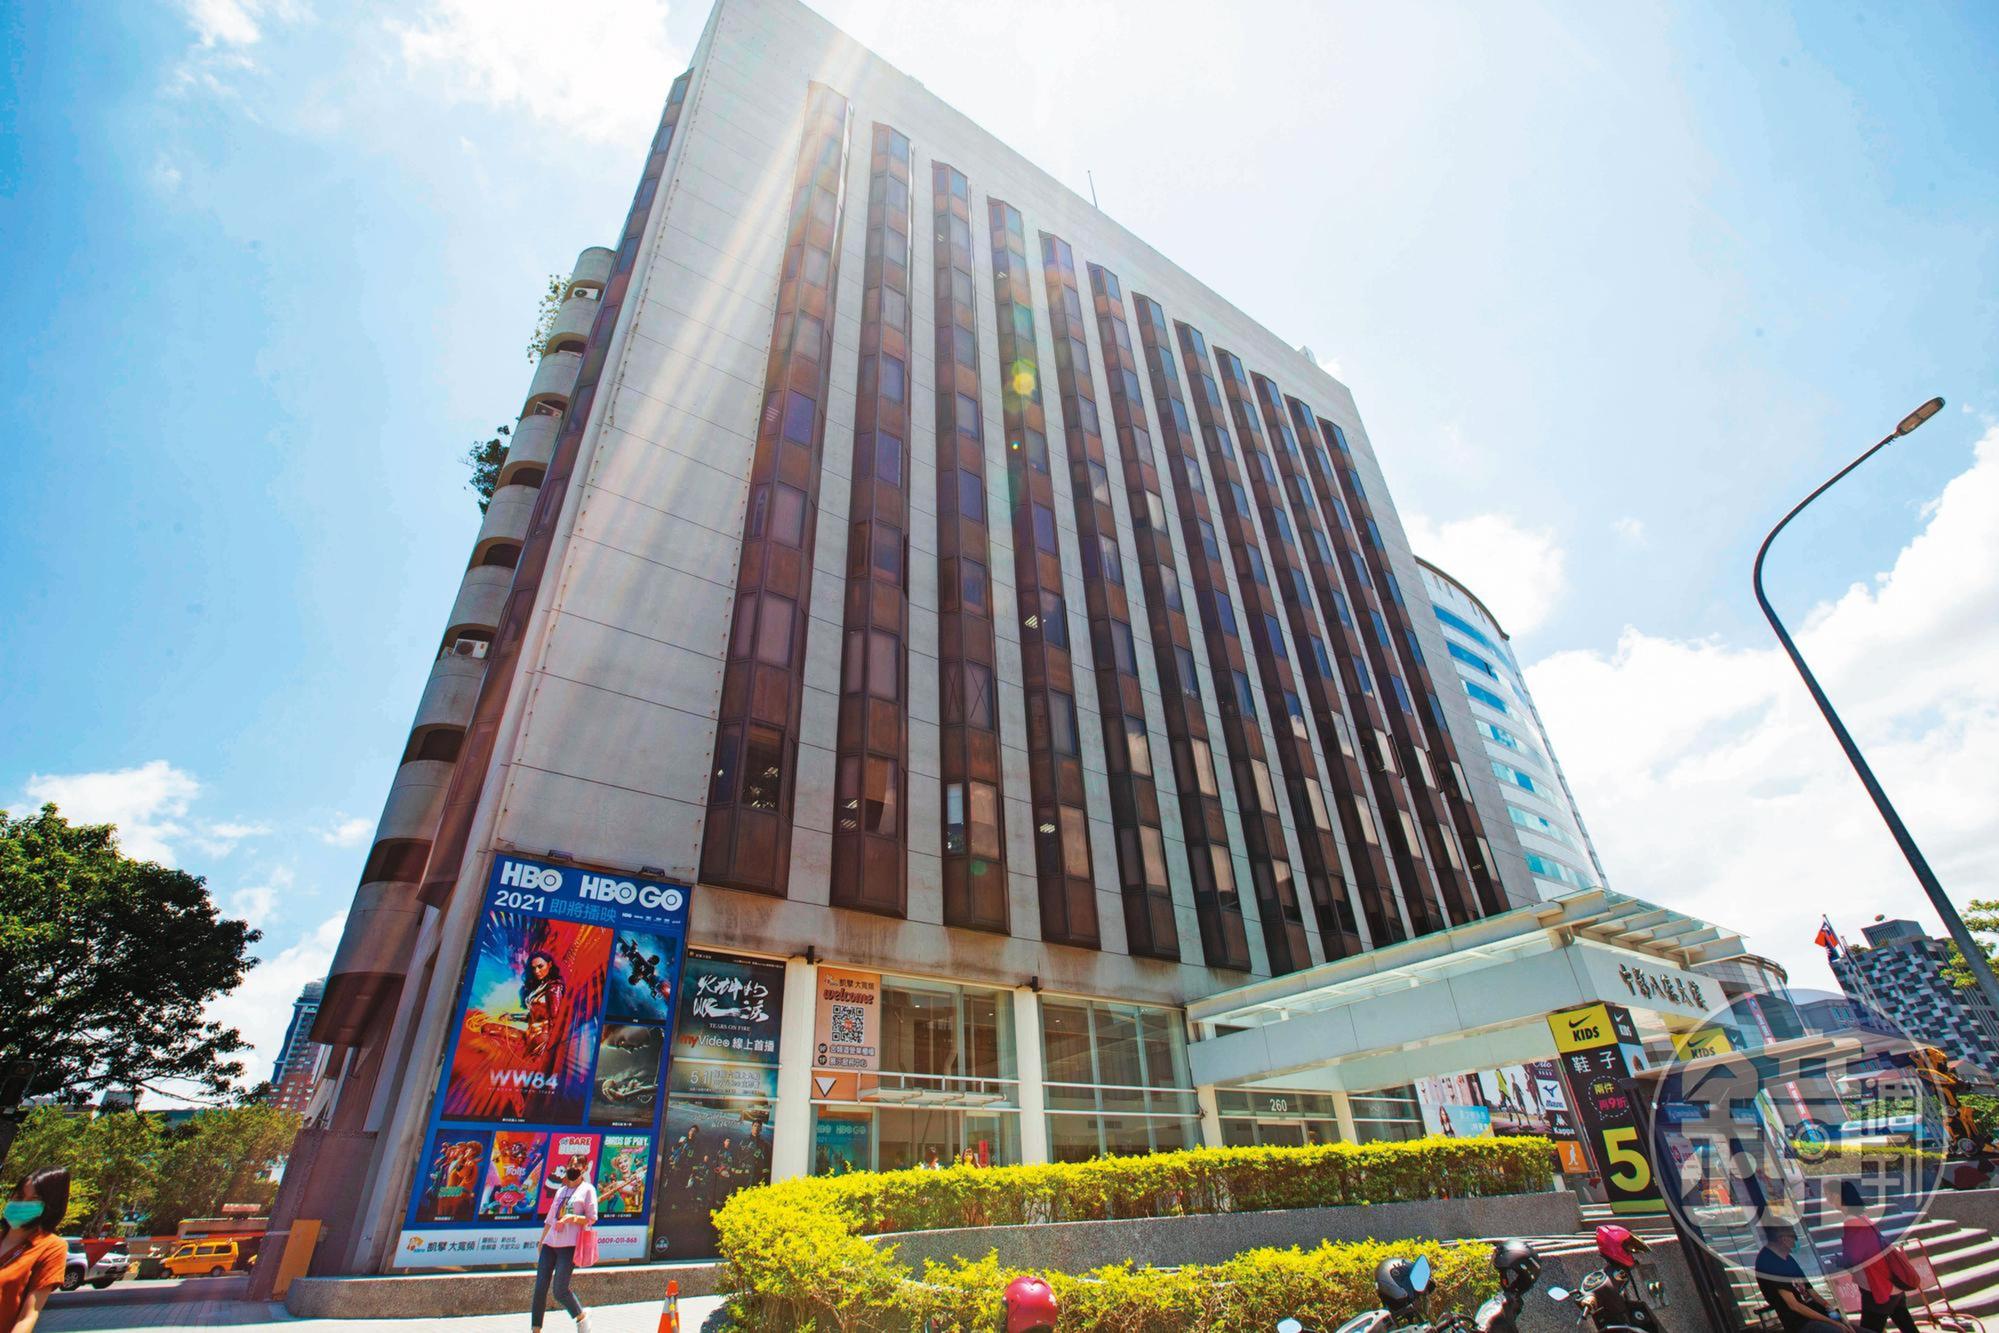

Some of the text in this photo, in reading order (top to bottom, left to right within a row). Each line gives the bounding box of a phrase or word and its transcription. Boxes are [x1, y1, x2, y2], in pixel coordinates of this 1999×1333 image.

[500, 861, 563, 892] HBO
[579, 875, 683, 912] HBO GO
[494, 891, 545, 912] 2021
[550, 898, 617, 923] 即將播映
[680, 1034, 775, 1052] myVideo 線上首播
[1572, 1026, 1600, 1042] KIDS
[490, 1069, 558, 1090] WW84
[1269, 1098, 1288, 1112] 260
[1552, 1126, 1575, 1136] Kappa
[1602, 1126, 1651, 1193] 5
